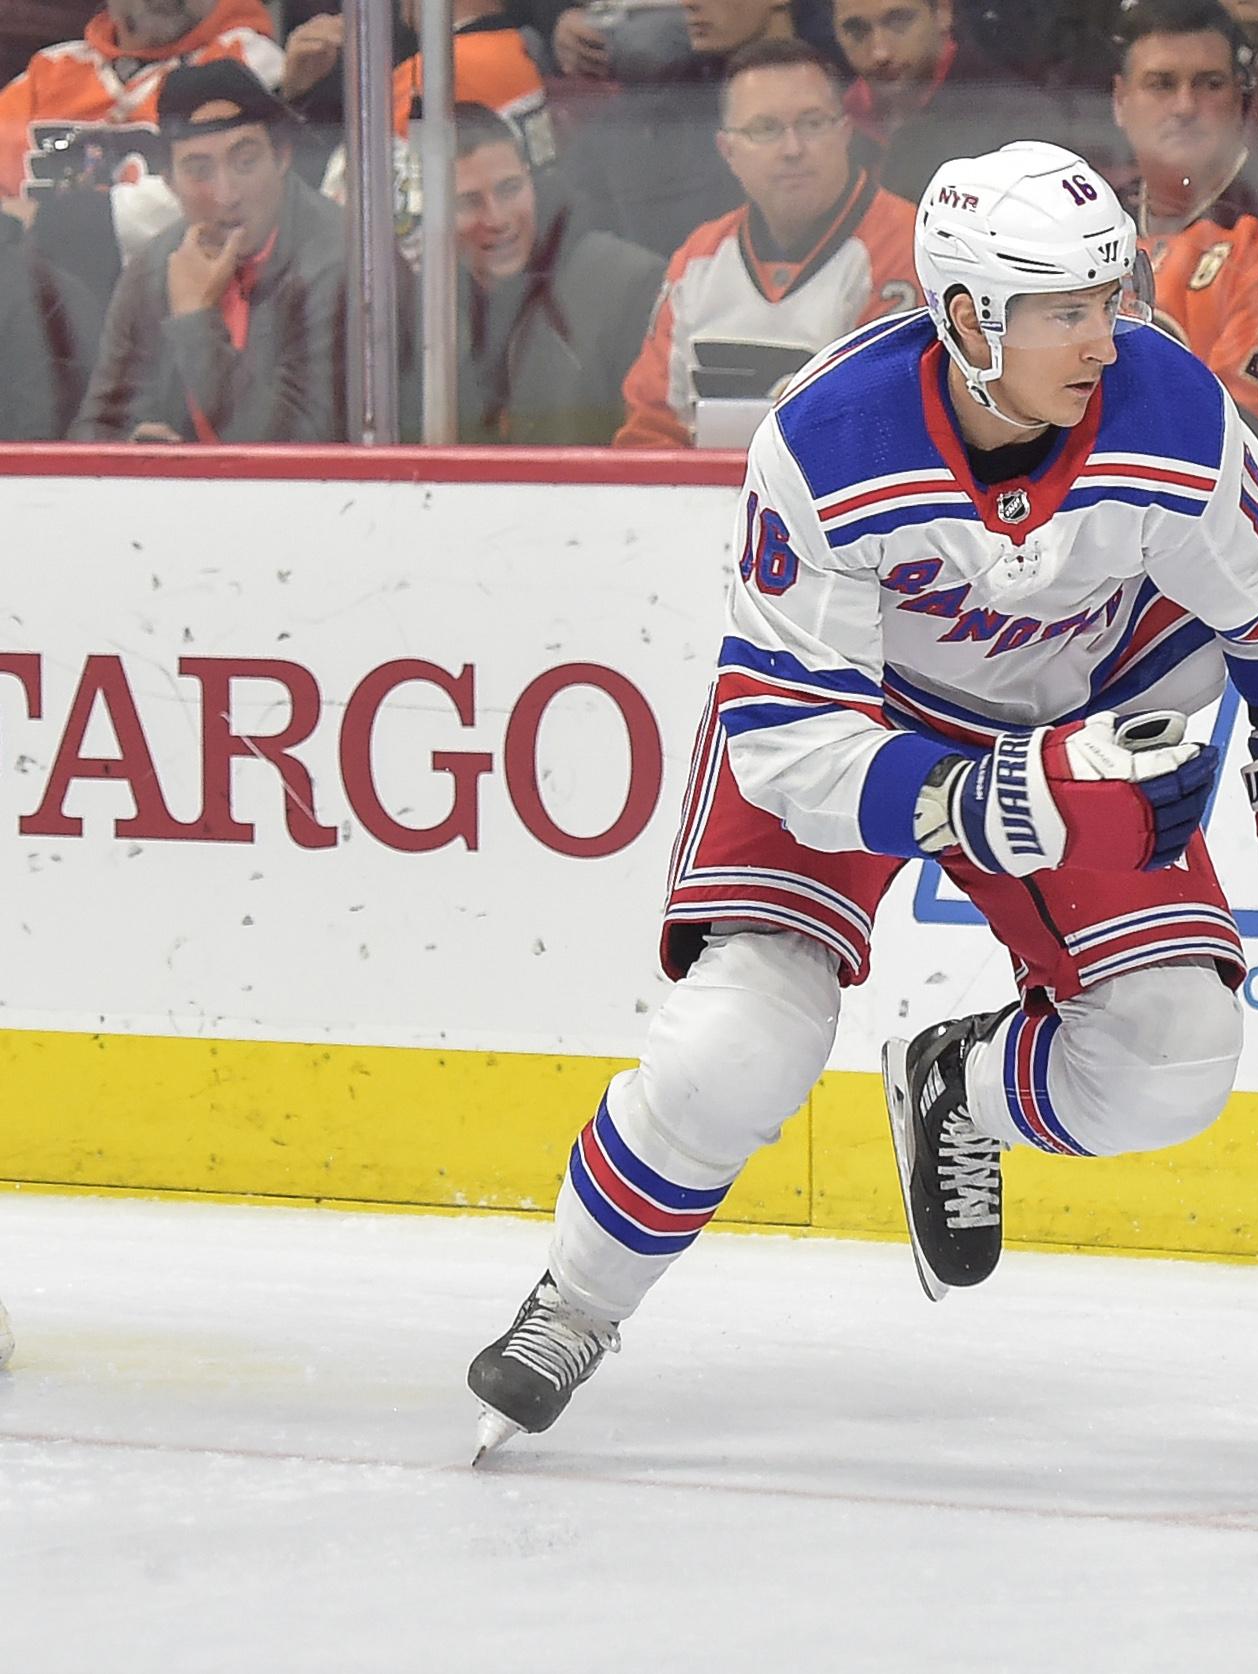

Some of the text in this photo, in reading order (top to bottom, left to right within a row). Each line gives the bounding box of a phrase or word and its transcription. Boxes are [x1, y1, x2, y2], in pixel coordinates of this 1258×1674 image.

[1061, 174, 1098, 206] 16
[739, 490, 800, 596] 16
[996, 731, 1046, 857] WARRI
